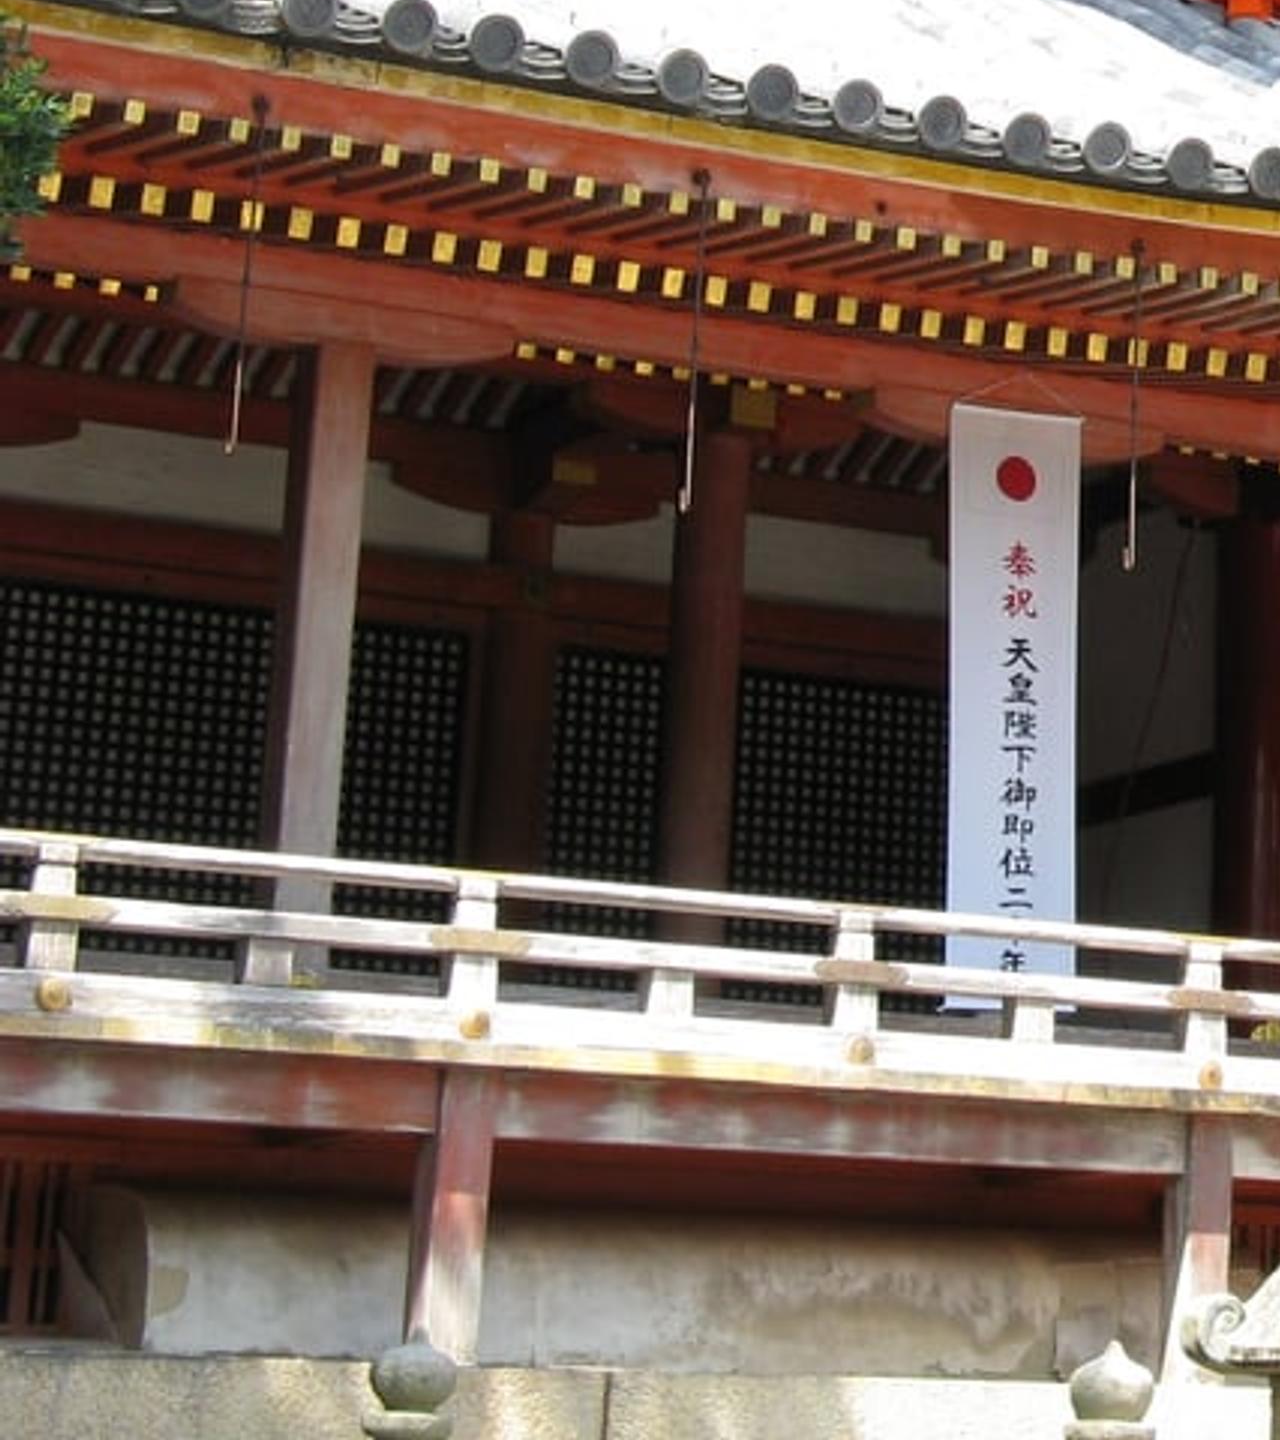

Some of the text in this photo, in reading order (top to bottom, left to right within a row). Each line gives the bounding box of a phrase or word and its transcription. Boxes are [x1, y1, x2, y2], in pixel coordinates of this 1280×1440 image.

[999, 539, 1038, 972] 奉祝 天皇陛下御即位二年
